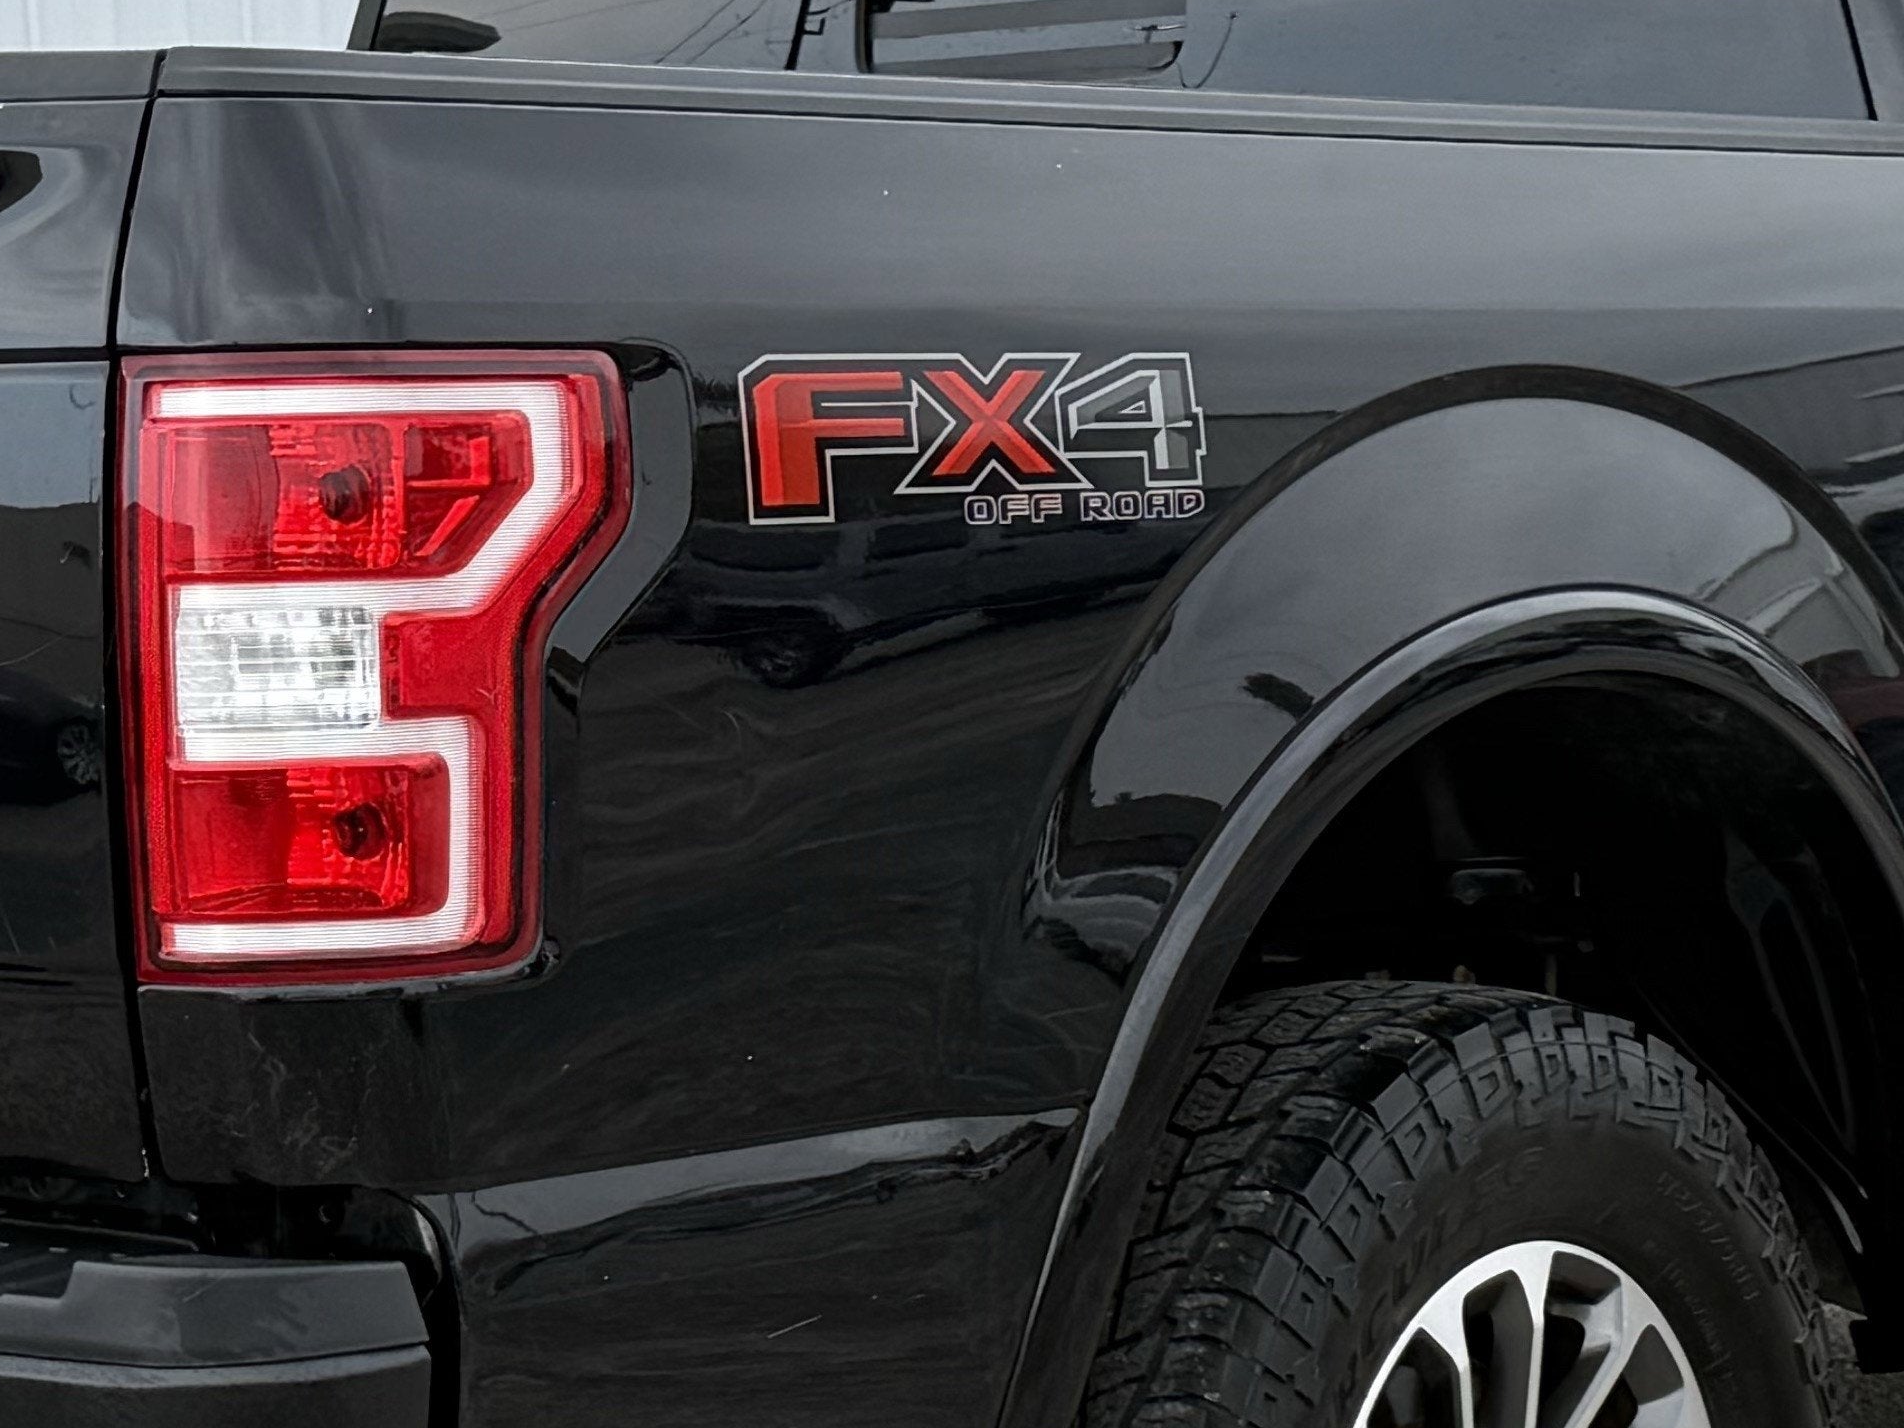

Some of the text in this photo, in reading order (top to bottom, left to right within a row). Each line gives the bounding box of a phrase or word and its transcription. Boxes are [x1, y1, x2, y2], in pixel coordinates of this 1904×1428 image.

[737, 353, 1206, 525] FX4
[965, 489, 1205, 525] OFF ROAD
